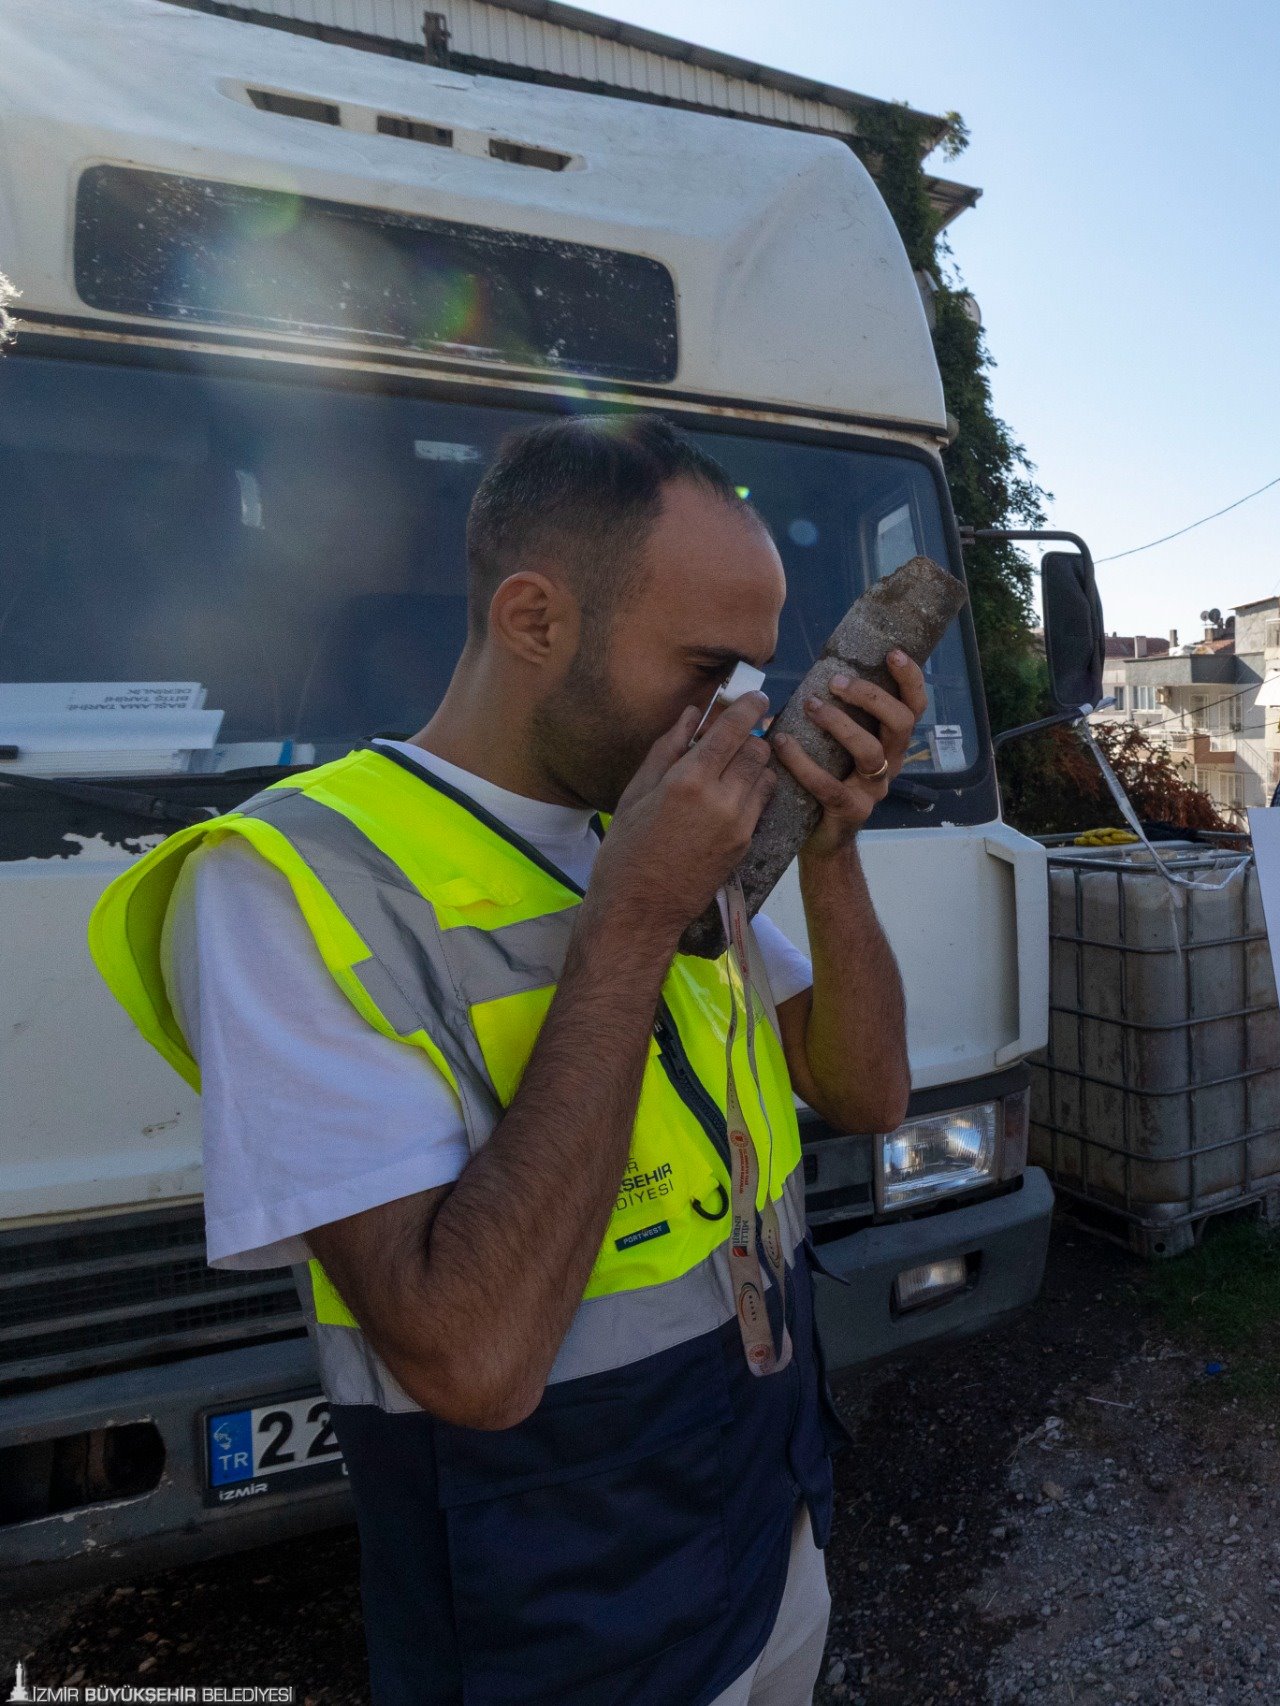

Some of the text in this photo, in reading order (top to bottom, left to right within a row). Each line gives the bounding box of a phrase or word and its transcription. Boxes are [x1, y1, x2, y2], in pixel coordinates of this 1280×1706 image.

[619, 1162, 673, 1193] ŞEHİR
[616, 1178, 674, 1211] DİYESİ
[623, 1225, 663, 1245] PORTWEST
[218, 1451, 249, 1471] TR
[218, 1482, 269, 1501] İZMİR
